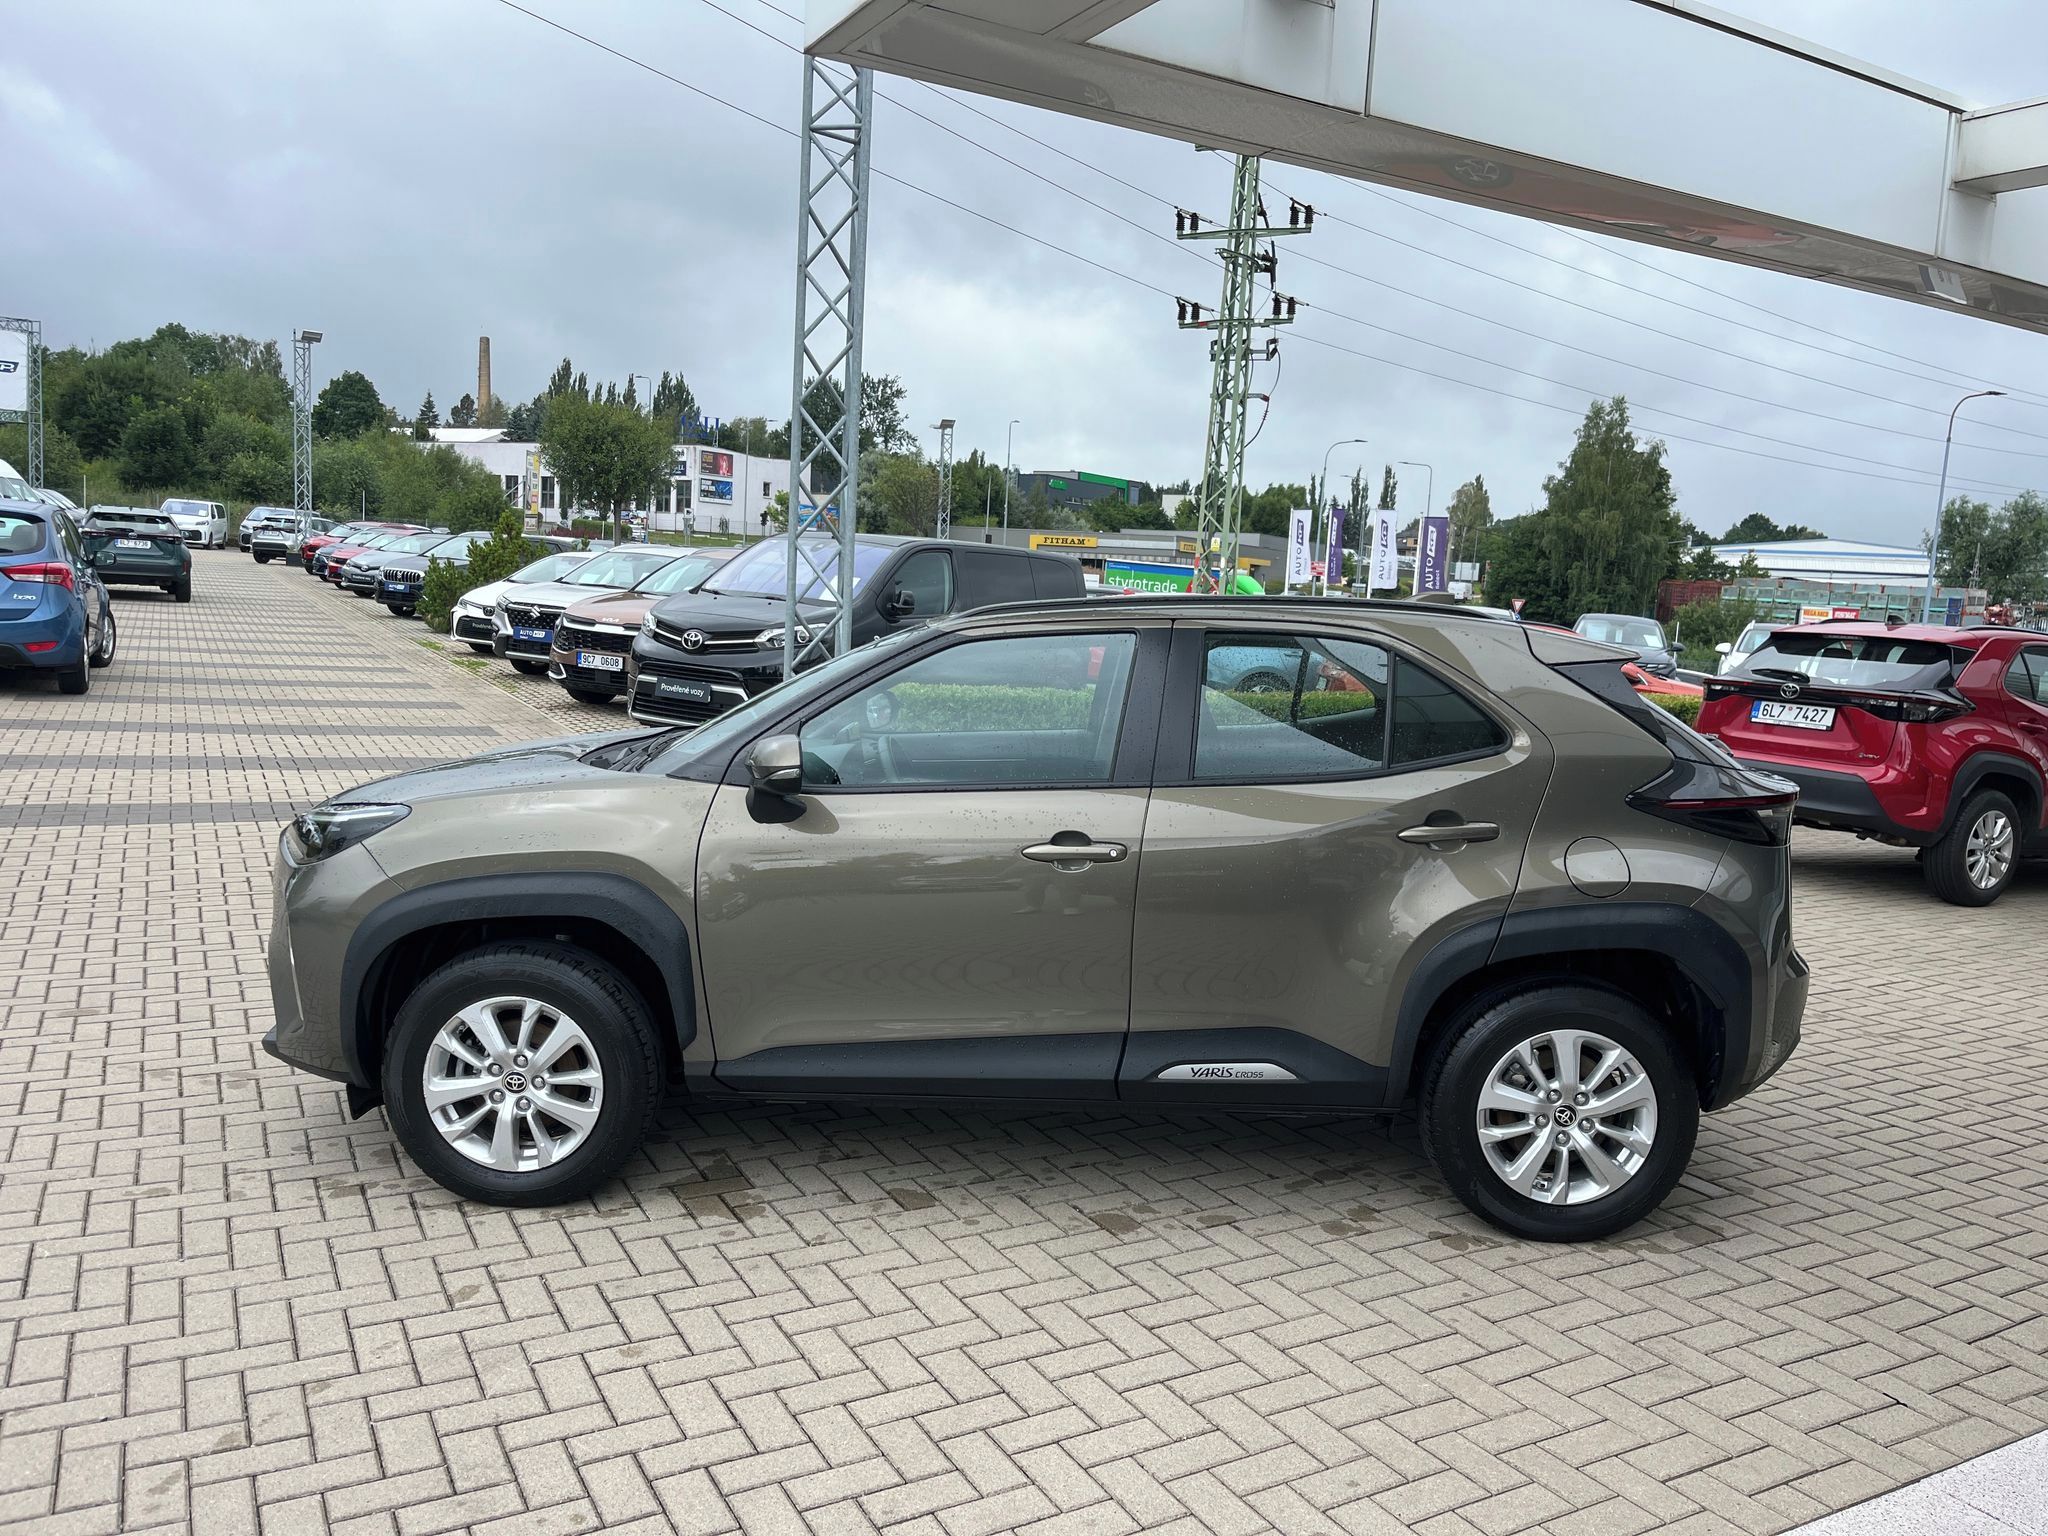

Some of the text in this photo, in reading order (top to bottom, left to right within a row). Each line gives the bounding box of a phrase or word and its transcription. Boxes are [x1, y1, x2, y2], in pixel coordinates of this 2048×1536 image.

[1043, 536, 1087, 545] FITHAM
[1378, 549, 1387, 580] AUTO
[1425, 557, 1434, 590] AUTO
[1108, 576, 1178, 592] styrotrade
[583, 655, 620, 667] 9C7 0608
[661, 683, 705, 698] Prověřené vozy
[1761, 703, 1829, 723] 6L7 7427
[1190, 1066, 1264, 1079] YARIS CROSS
